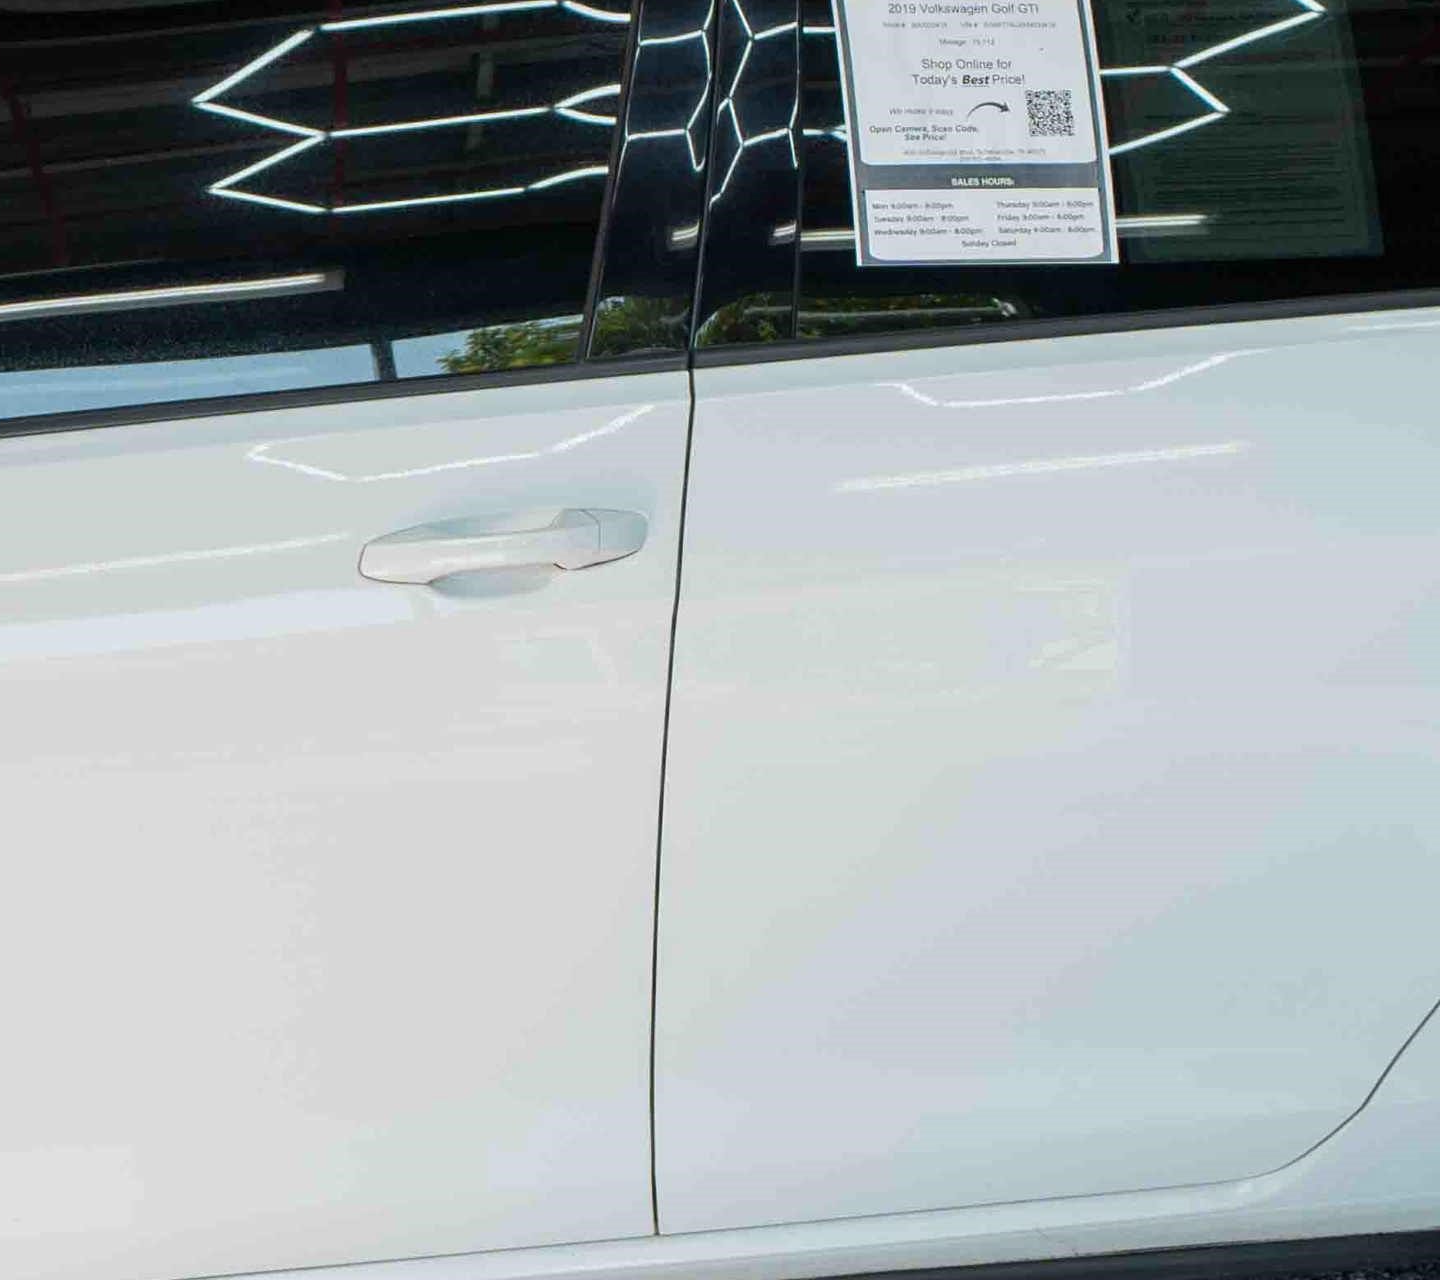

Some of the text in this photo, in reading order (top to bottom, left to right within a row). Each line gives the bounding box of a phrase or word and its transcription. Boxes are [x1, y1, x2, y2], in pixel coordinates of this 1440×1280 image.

[887, 3, 917, 15] 2019
[918, 3, 988, 17] Volkswagen
[990, 3, 1016, 15] Golf
[921, 58, 1013, 71] Shop Online for
[912, 74, 1026, 87] Today's Best Price!
[951, 177, 980, 186] SALES
